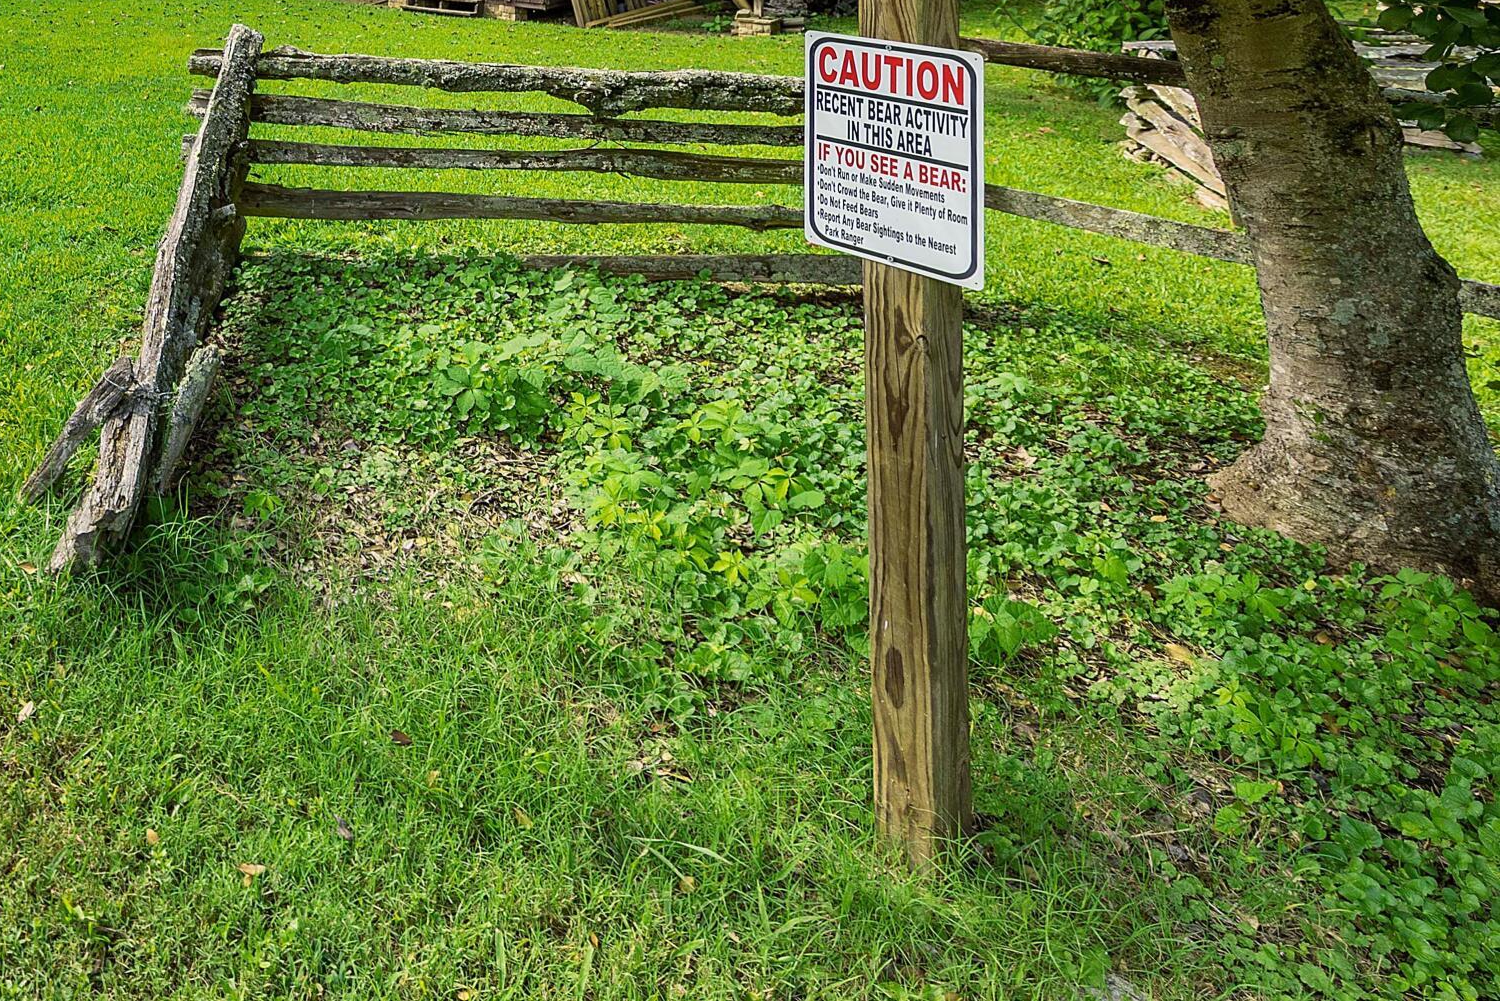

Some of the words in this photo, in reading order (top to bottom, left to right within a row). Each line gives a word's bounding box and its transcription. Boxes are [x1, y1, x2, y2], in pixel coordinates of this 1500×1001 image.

[819, 46, 964, 105] CAUTION
[817, 91, 863, 118] RECENT
[868, 99, 901, 126] BEAR
[906, 107, 968, 138] ACTIVITY
[847, 120, 859, 141] IN
[864, 124, 892, 148] THIS
[897, 130, 932, 157] AREA
[818, 143, 830, 160] IF
[835, 146, 865, 169] YOU
[870, 154, 898, 177] SEE
[904, 162, 913, 181] A
[919, 165, 967, 193] BEAR:
[820, 163, 835, 177] Don't
[838, 168, 849, 179] Run
[851, 173, 858, 181] or
[860, 173, 877, 186] Make
[879, 178, 903, 193] Sudden
[905, 184, 945, 203] Movements
[820, 179, 835, 192] Don't
[837, 183, 858, 197] Crowd
[859, 189, 869, 200] the
[871, 191, 889, 208] Bear,
[890, 196, 906, 210] Give
[907, 200, 913, 211] it
[915, 201, 936, 220] Plenty
[938, 207, 945, 219] of
[947, 210, 968, 225] Room
[820, 194, 828, 205] Do
[830, 197, 841, 209] Not
[842, 200, 858, 213] Feed
[860, 204, 879, 218] Bears
[820, 210, 841, 224] Report
[842, 216, 854, 230] Any
[856, 219, 871, 232] Bear
[873, 222, 904, 242] Sightings
[906, 232, 913, 242] to
[915, 234, 926, 246] the
[928, 237, 957, 255] Nearest
[825, 226, 839, 239] Park
[841, 230, 864, 245] Ranger
